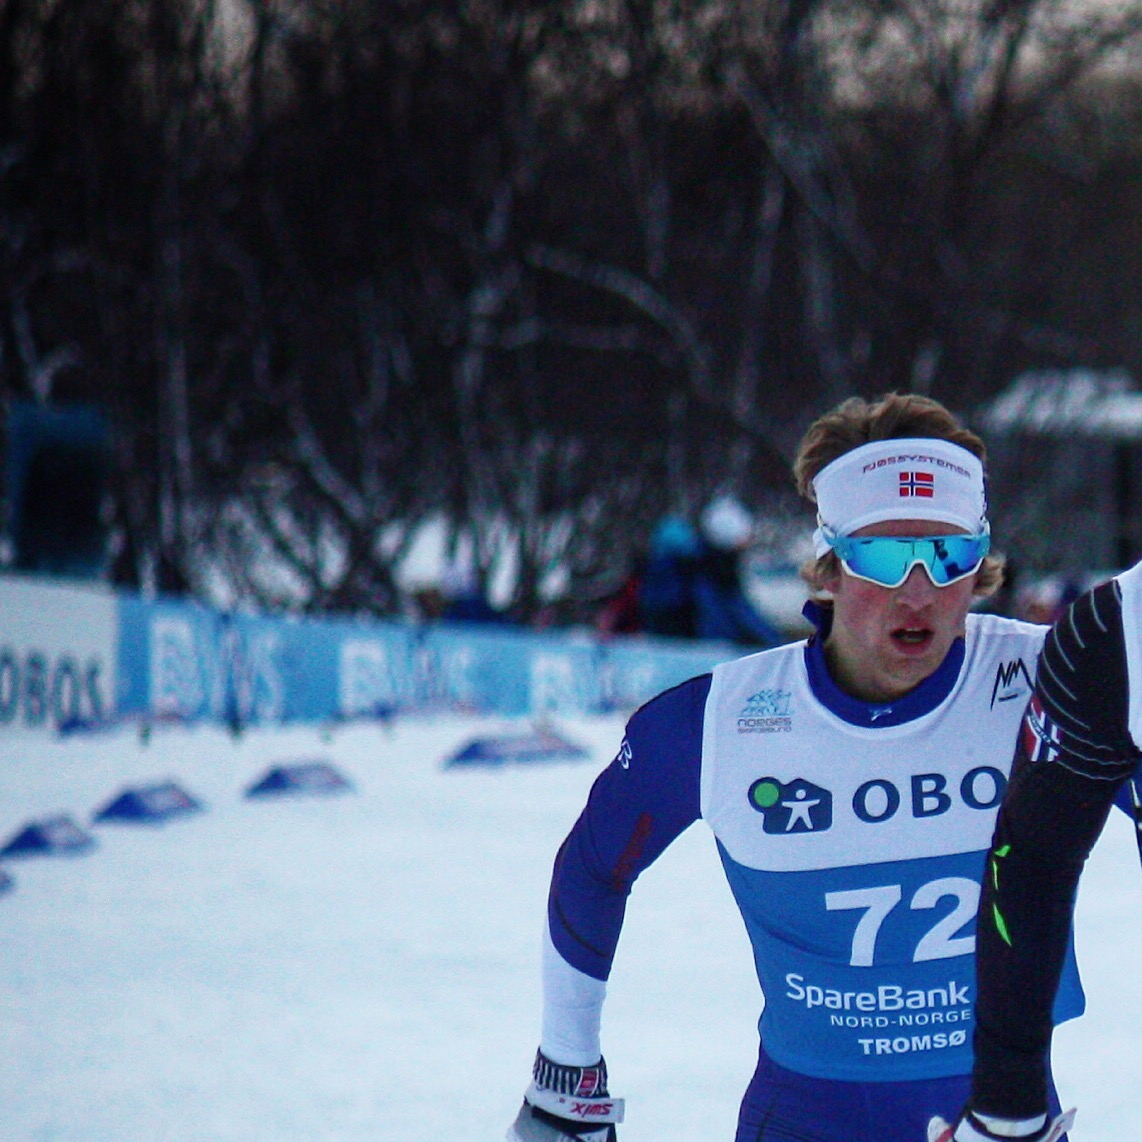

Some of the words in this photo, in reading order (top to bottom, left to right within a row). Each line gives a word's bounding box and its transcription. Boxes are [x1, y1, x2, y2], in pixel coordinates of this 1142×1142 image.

[852, 766, 1009, 823] OBO
[824, 877, 981, 967] 72
[786, 973, 970, 1012] SpareBank
[830, 1009, 971, 1028] NORD-NORGE
[858, 1030, 967, 1055] TROMSØ
